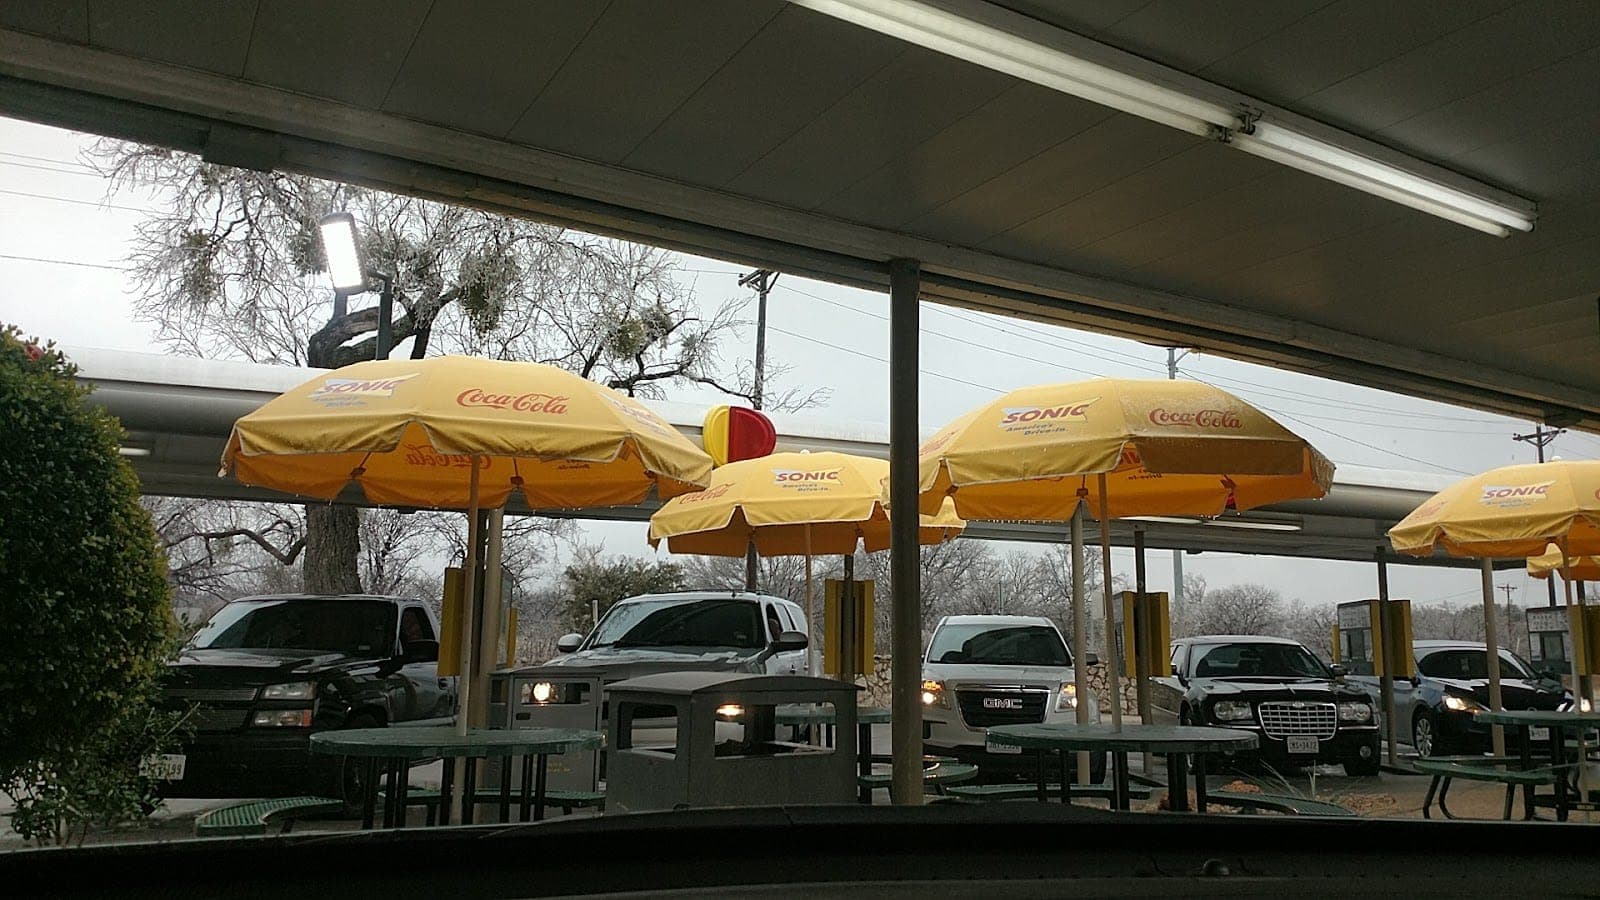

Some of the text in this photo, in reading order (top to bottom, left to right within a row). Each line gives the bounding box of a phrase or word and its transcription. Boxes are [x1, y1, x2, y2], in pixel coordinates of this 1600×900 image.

[317, 379, 405, 394] SONIC
[1001, 404, 1090, 424] SONIC
[775, 471, 839, 482] SONIC
[1483, 485, 1550, 499] SONIC
[983, 697, 1023, 709] GMC
